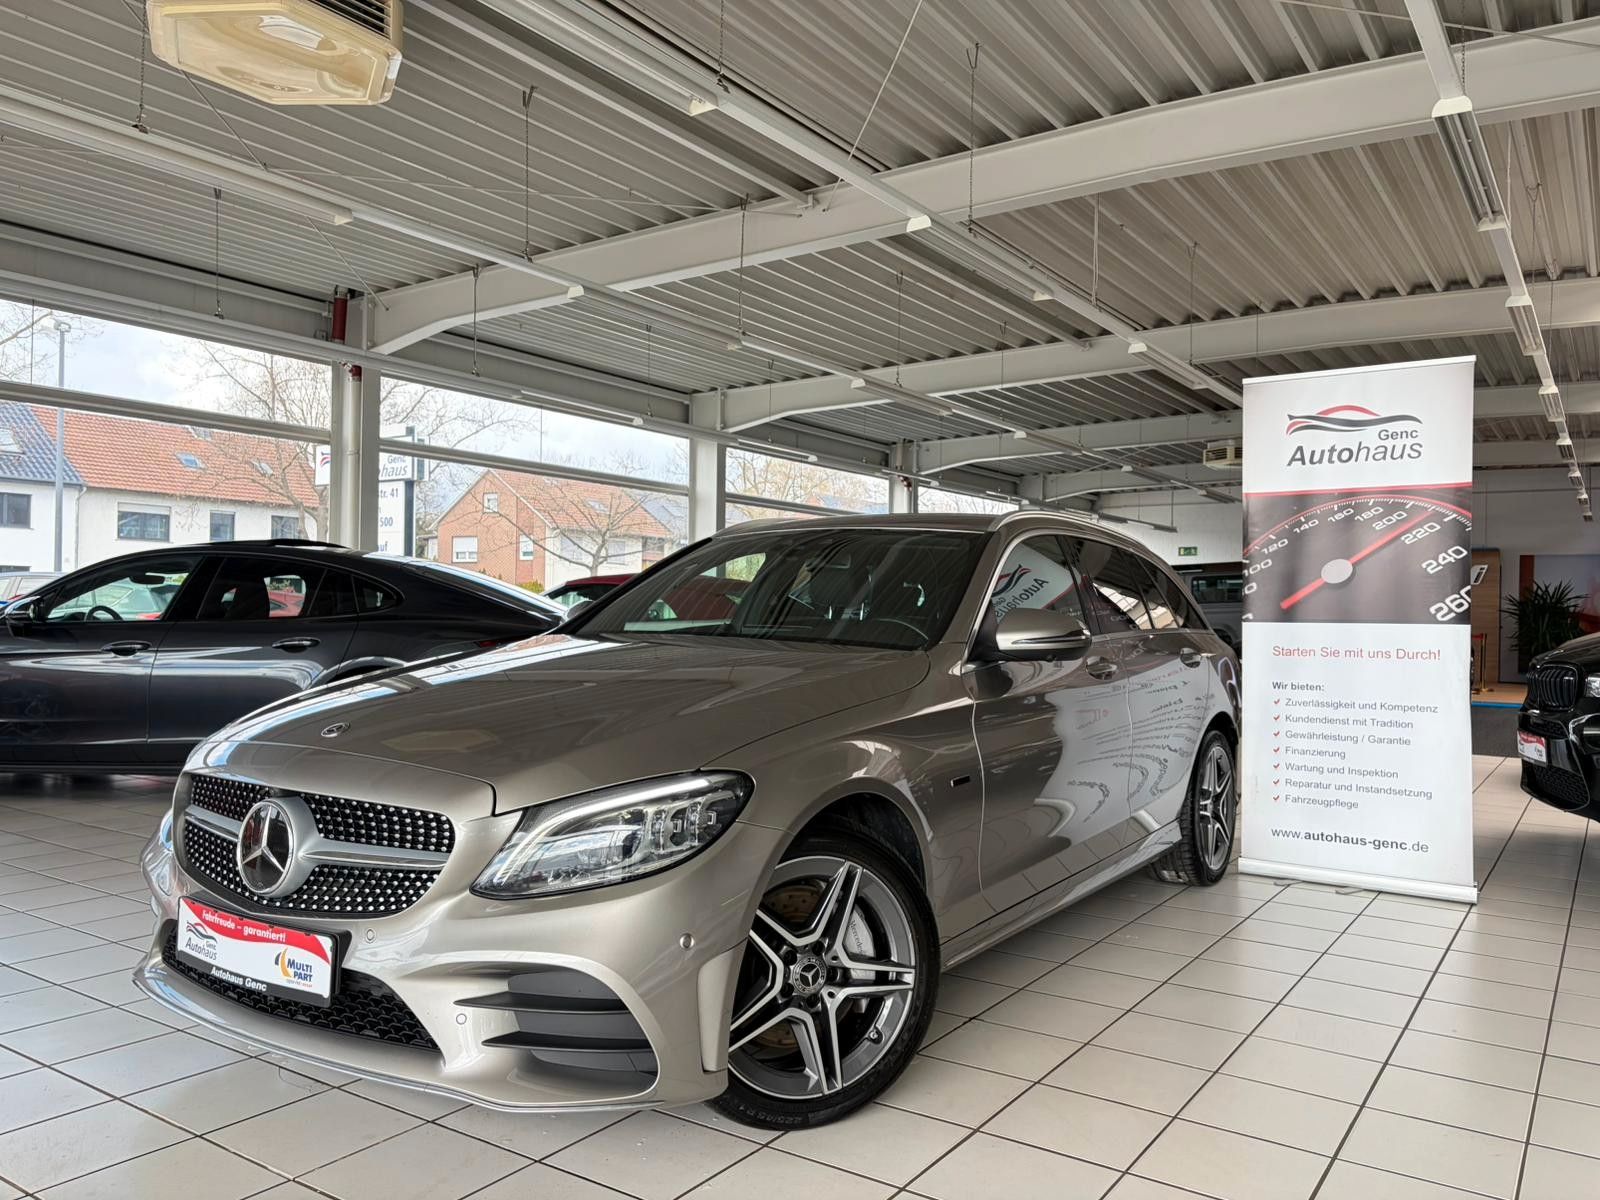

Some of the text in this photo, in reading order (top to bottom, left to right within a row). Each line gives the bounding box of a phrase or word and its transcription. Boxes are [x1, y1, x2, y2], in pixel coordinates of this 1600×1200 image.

[1377, 429, 1419, 440] Genc
[1286, 441, 1423, 466] Autohaus
[379, 464, 408, 477] haus
[390, 488, 398, 498] 41
[1327, 507, 1354, 523] 160
[1354, 506, 1384, 522] 180
[1372, 510, 1407, 530] 200
[1293, 519, 1319, 533] 140
[1400, 521, 1441, 545] 220
[1262, 538, 1289, 554] 120
[1242, 559, 1272, 577] 100
[1421, 545, 1468, 575] 240
[1242, 582, 1257, 595] 0
[1272, 645, 1441, 660] Starten Sie mit uns Durch!
[1272, 681, 1325, 692] Wir bieten:
[1285, 698, 1439, 714] Zuverlässigkeit und Kompetenz
[1285, 714, 1413, 729] Kundendienst mit Tradition
[1285, 730, 1359, 744] Gewährleistung
[1367, 734, 1411, 746] Garantie
[1285, 746, 1346, 760] Finanzierung
[1285, 762, 1399, 779] Wartung und Inspektion
[1285, 778, 1433, 800] Reparatur und Instandsetzung
[1285, 794, 1359, 810] Fahrzeugpflege
[1271, 828, 1430, 853] www.autohaus-genc.de
[201, 909, 236, 930] Fahrfreude
[243, 926, 286, 942] garantiert!
[185, 937, 217, 961] Autohaus
[205, 940, 217, 950] Genc
[286, 958, 313, 973] MULTI
[210, 966, 244, 985] Autohaus
[244, 977, 268, 992] Genc
[293, 970, 313, 982] PART
